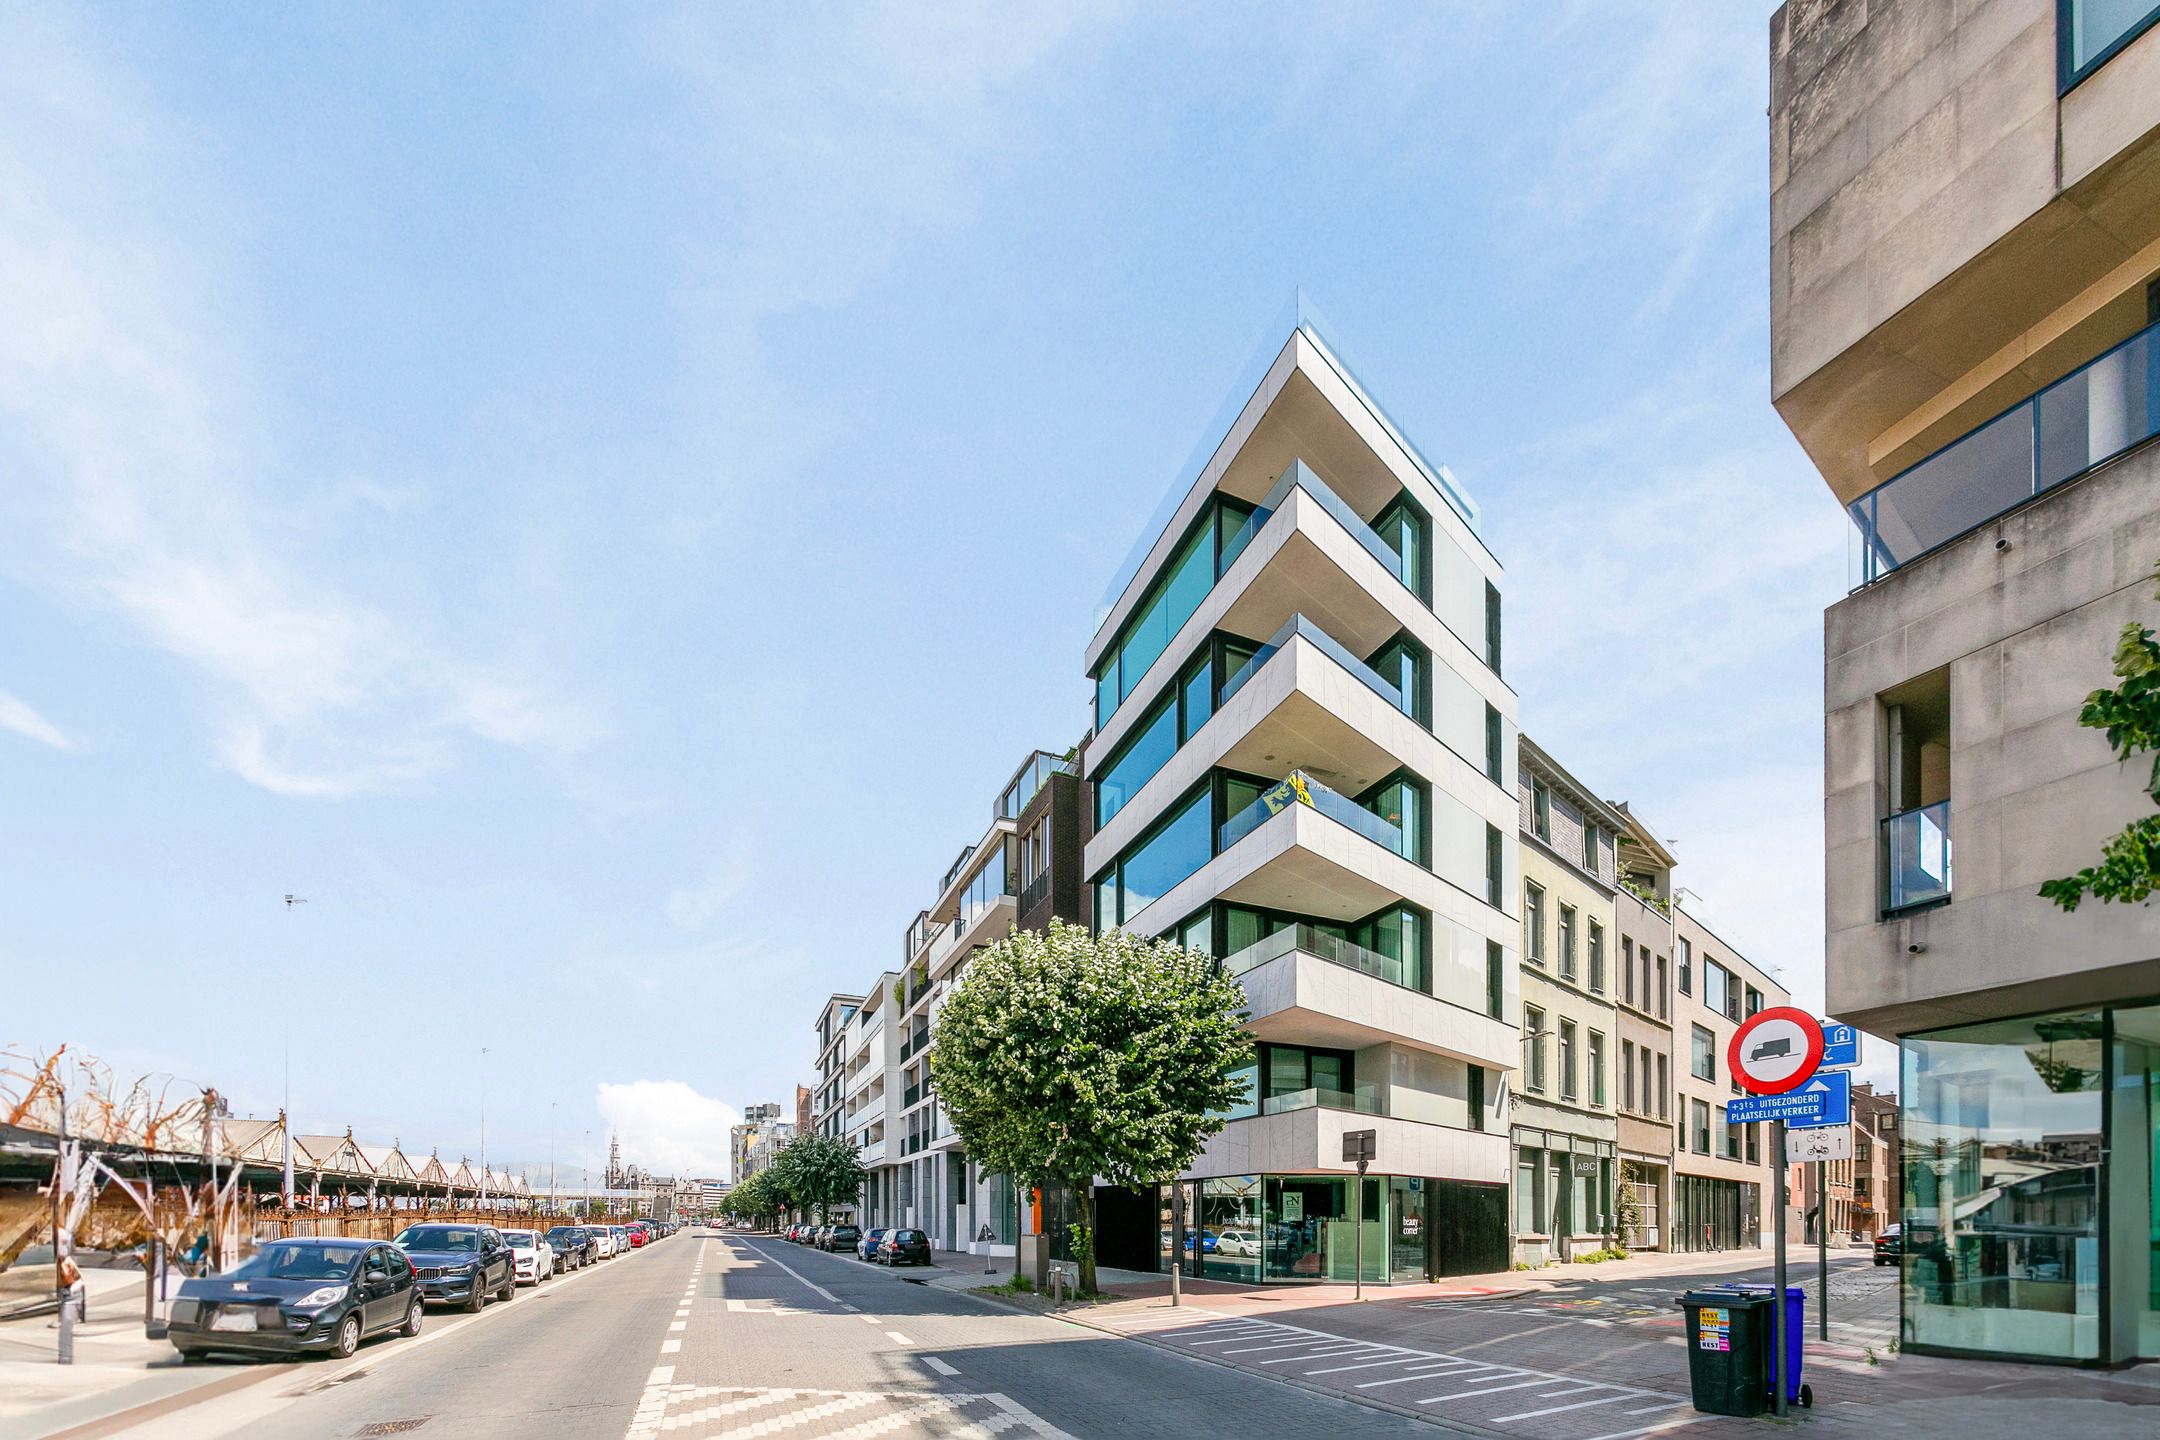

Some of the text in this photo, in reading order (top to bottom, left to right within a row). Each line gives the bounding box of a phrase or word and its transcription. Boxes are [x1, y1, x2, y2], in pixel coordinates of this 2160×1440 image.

[1760, 1094, 1819, 1108] UITGEZONDERD
[1731, 1105, 1819, 1121] PLAATSELIJK VERKEER
[1576, 1162, 1596, 1171] ABC
[1403, 1216, 1419, 1228] beauty
